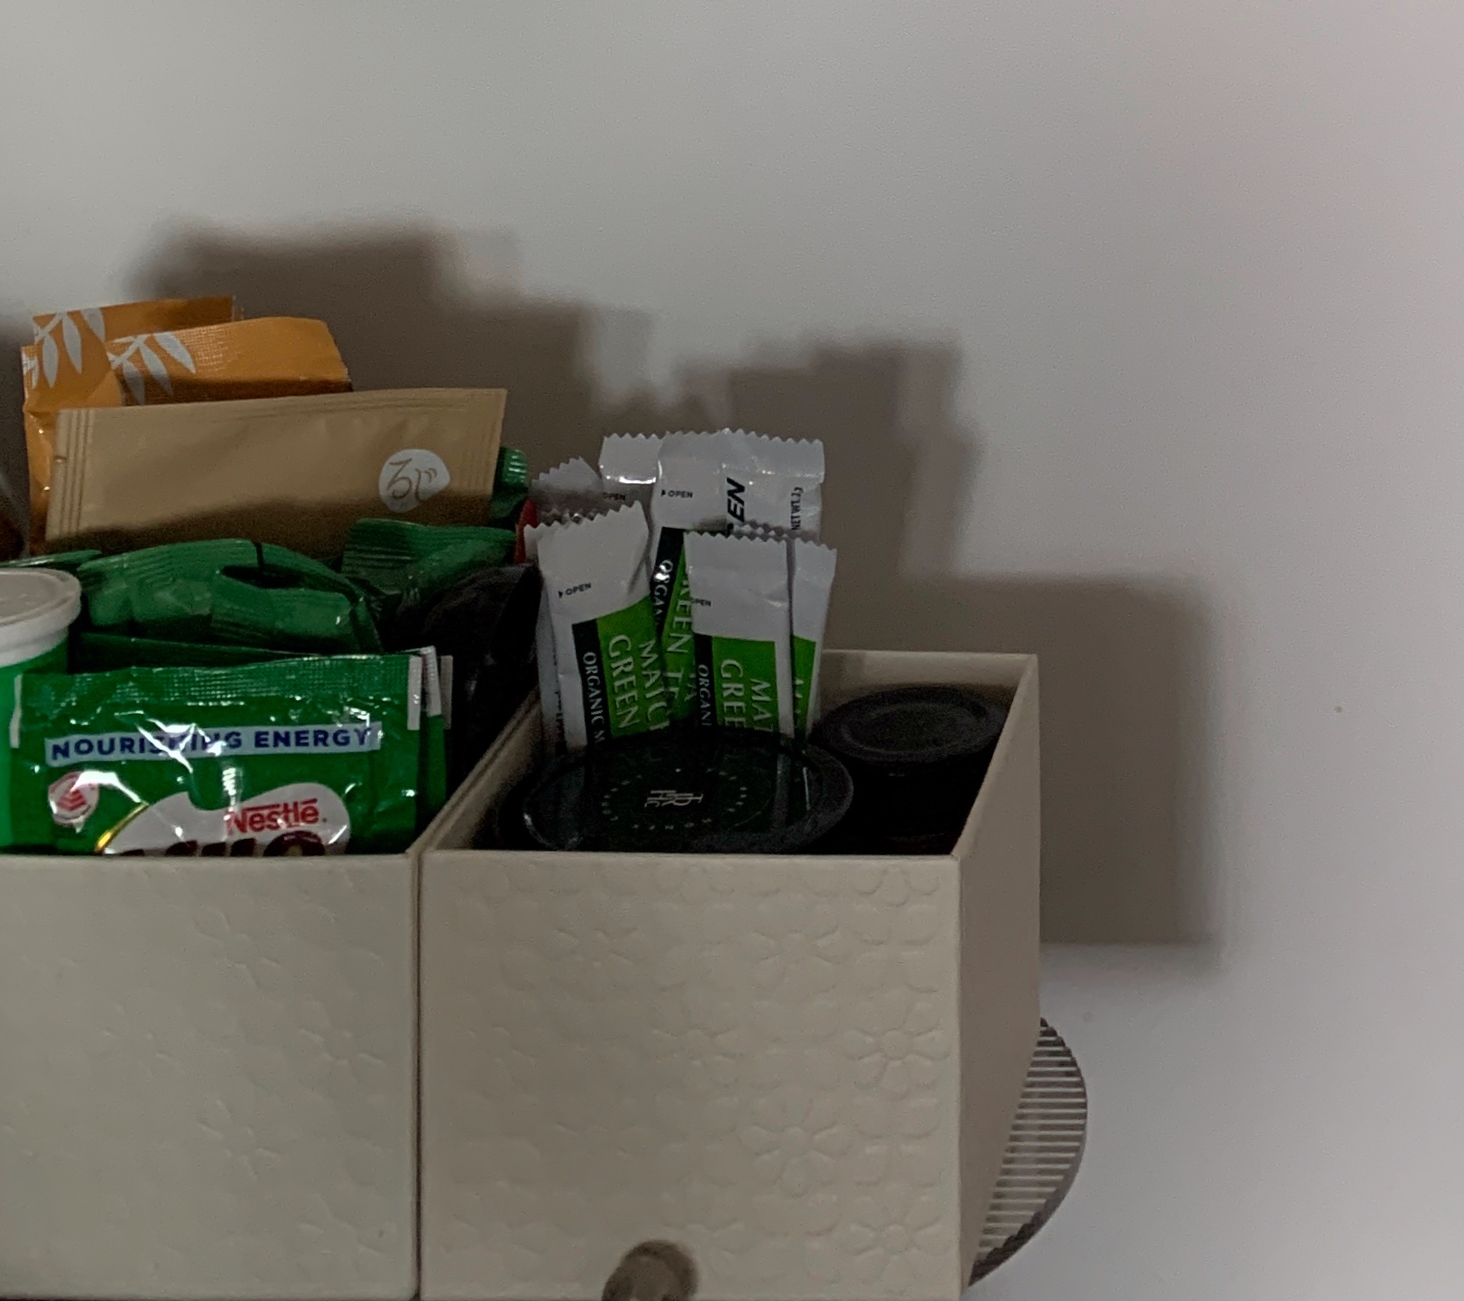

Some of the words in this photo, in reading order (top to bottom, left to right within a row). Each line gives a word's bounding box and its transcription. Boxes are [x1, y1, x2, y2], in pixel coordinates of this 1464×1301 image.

[668, 489, 694, 498] OPEN
[565, 582, 592, 596] OPEN
[582, 651, 605, 726] ORGANIC
[608, 634, 641, 729] GREEN
[697, 663, 713, 727] ORGANI
[720, 658, 747, 729] GREE
[254, 727, 373, 749] ENERGY
[226, 798, 320, 835] Nestlé
